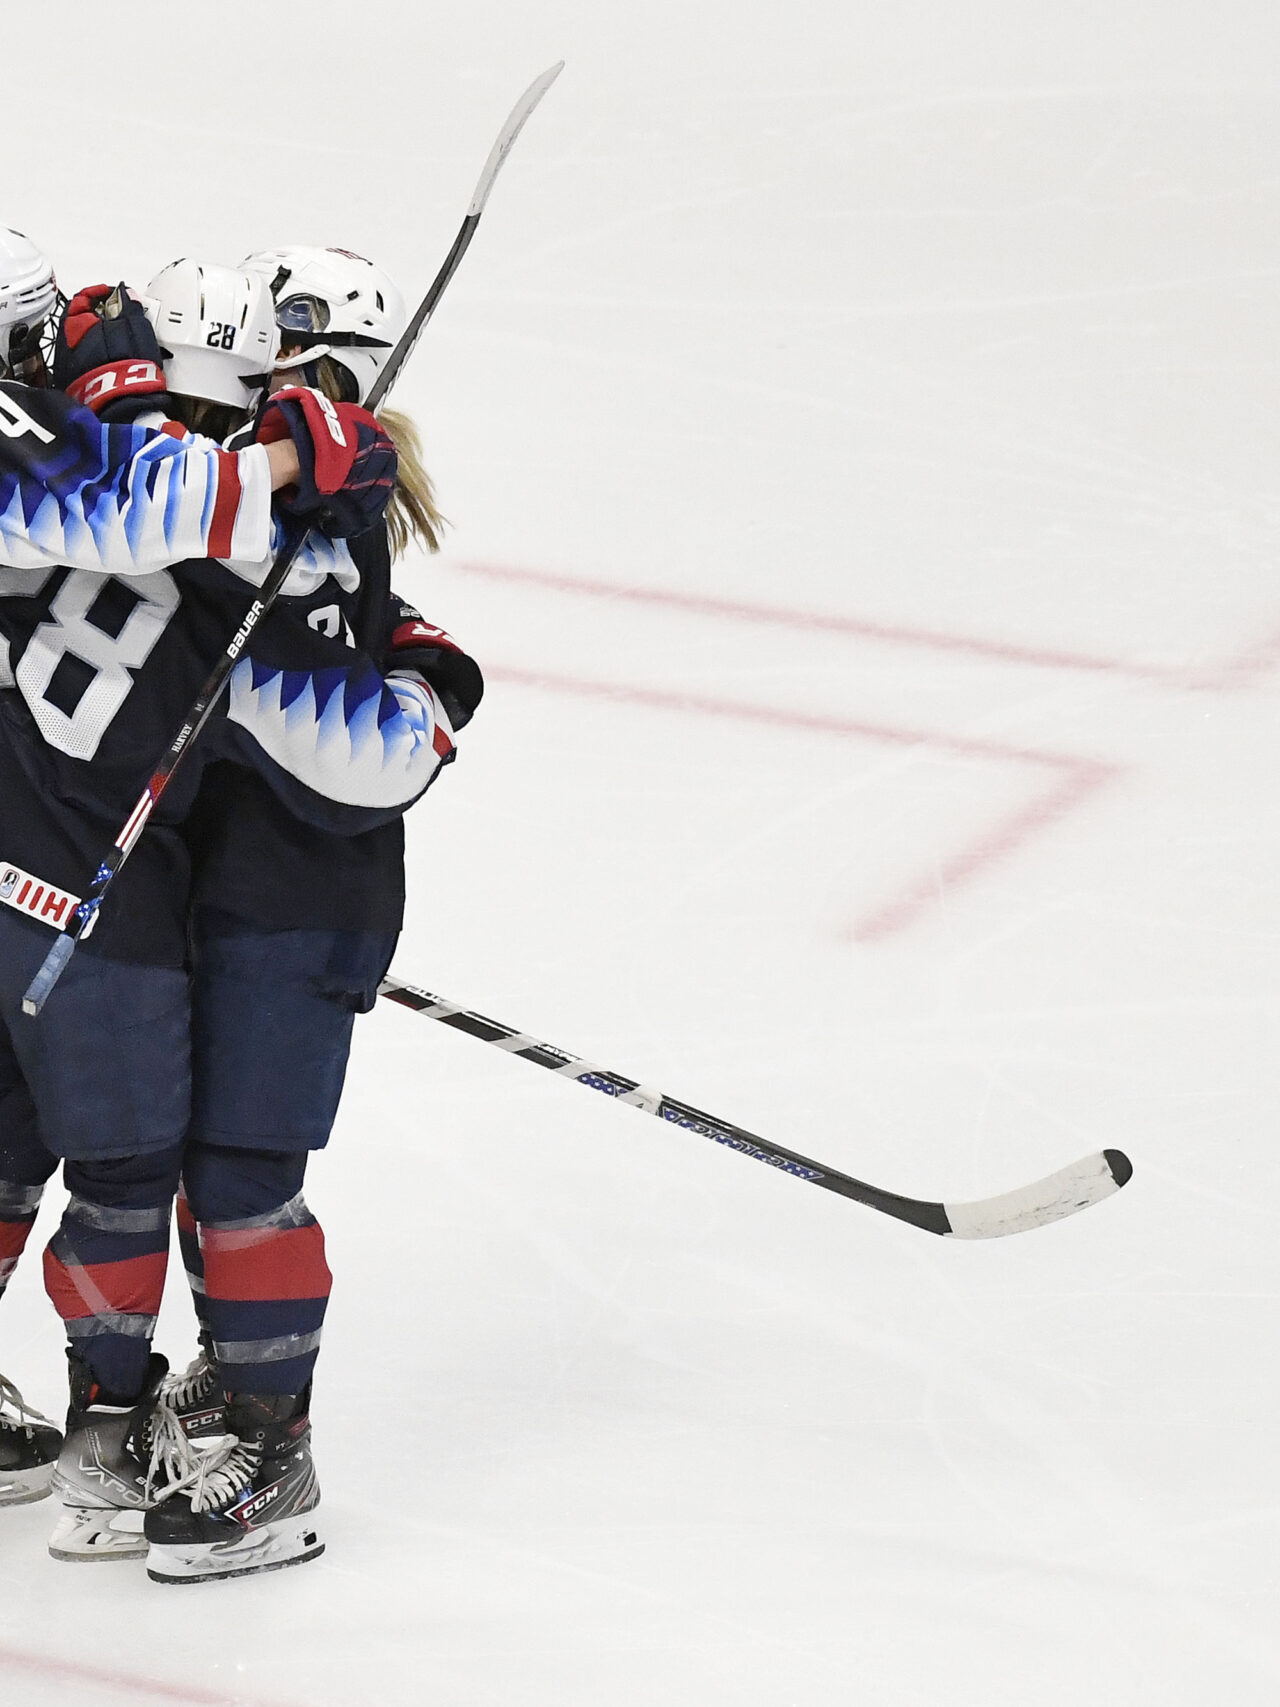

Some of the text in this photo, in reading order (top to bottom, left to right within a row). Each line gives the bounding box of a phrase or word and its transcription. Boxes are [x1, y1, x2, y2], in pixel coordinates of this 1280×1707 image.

[206, 321, 237, 351] 28
[226, 599, 265, 660] BAUER
[171, 723, 193, 753] HARVEY
[78, 1454, 146, 1506] VAPO
[241, 1486, 280, 1520] CCM
